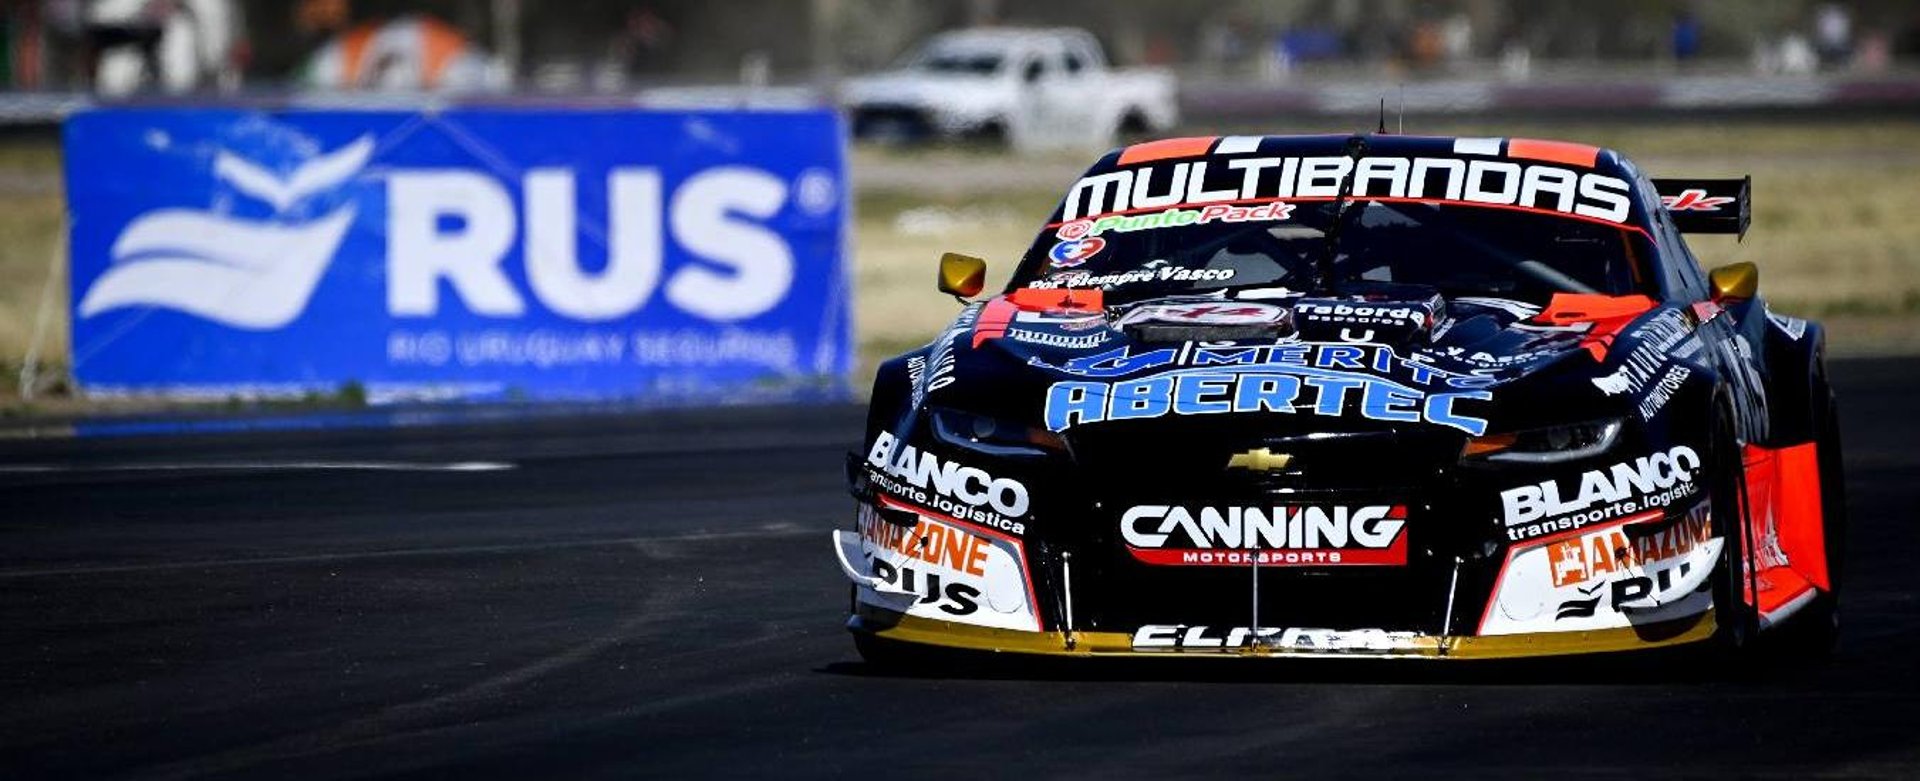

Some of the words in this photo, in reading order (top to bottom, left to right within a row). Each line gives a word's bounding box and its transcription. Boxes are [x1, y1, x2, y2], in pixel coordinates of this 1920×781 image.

[1062, 155, 1631, 223] MULTIBANDAS
[387, 167, 795, 321] RUS
[1091, 201, 1297, 236] PuntoPack
[1068, 271, 1153, 287] Siempre
[1160, 266, 1235, 282] Vasco
[387, 330, 451, 366] RIO
[456, 329, 625, 369] URUGUAY
[632, 328, 797, 370] SEGUROS
[1044, 373, 1493, 437] ABERTEC
[1638, 364, 1691, 422] AUTOMOTORES
[868, 430, 1029, 517] BLANCO
[1500, 446, 1700, 527] BLANCO
[1121, 505, 1405, 549] CANNING
[1183, 551, 1342, 564] MOTORSPORTS
